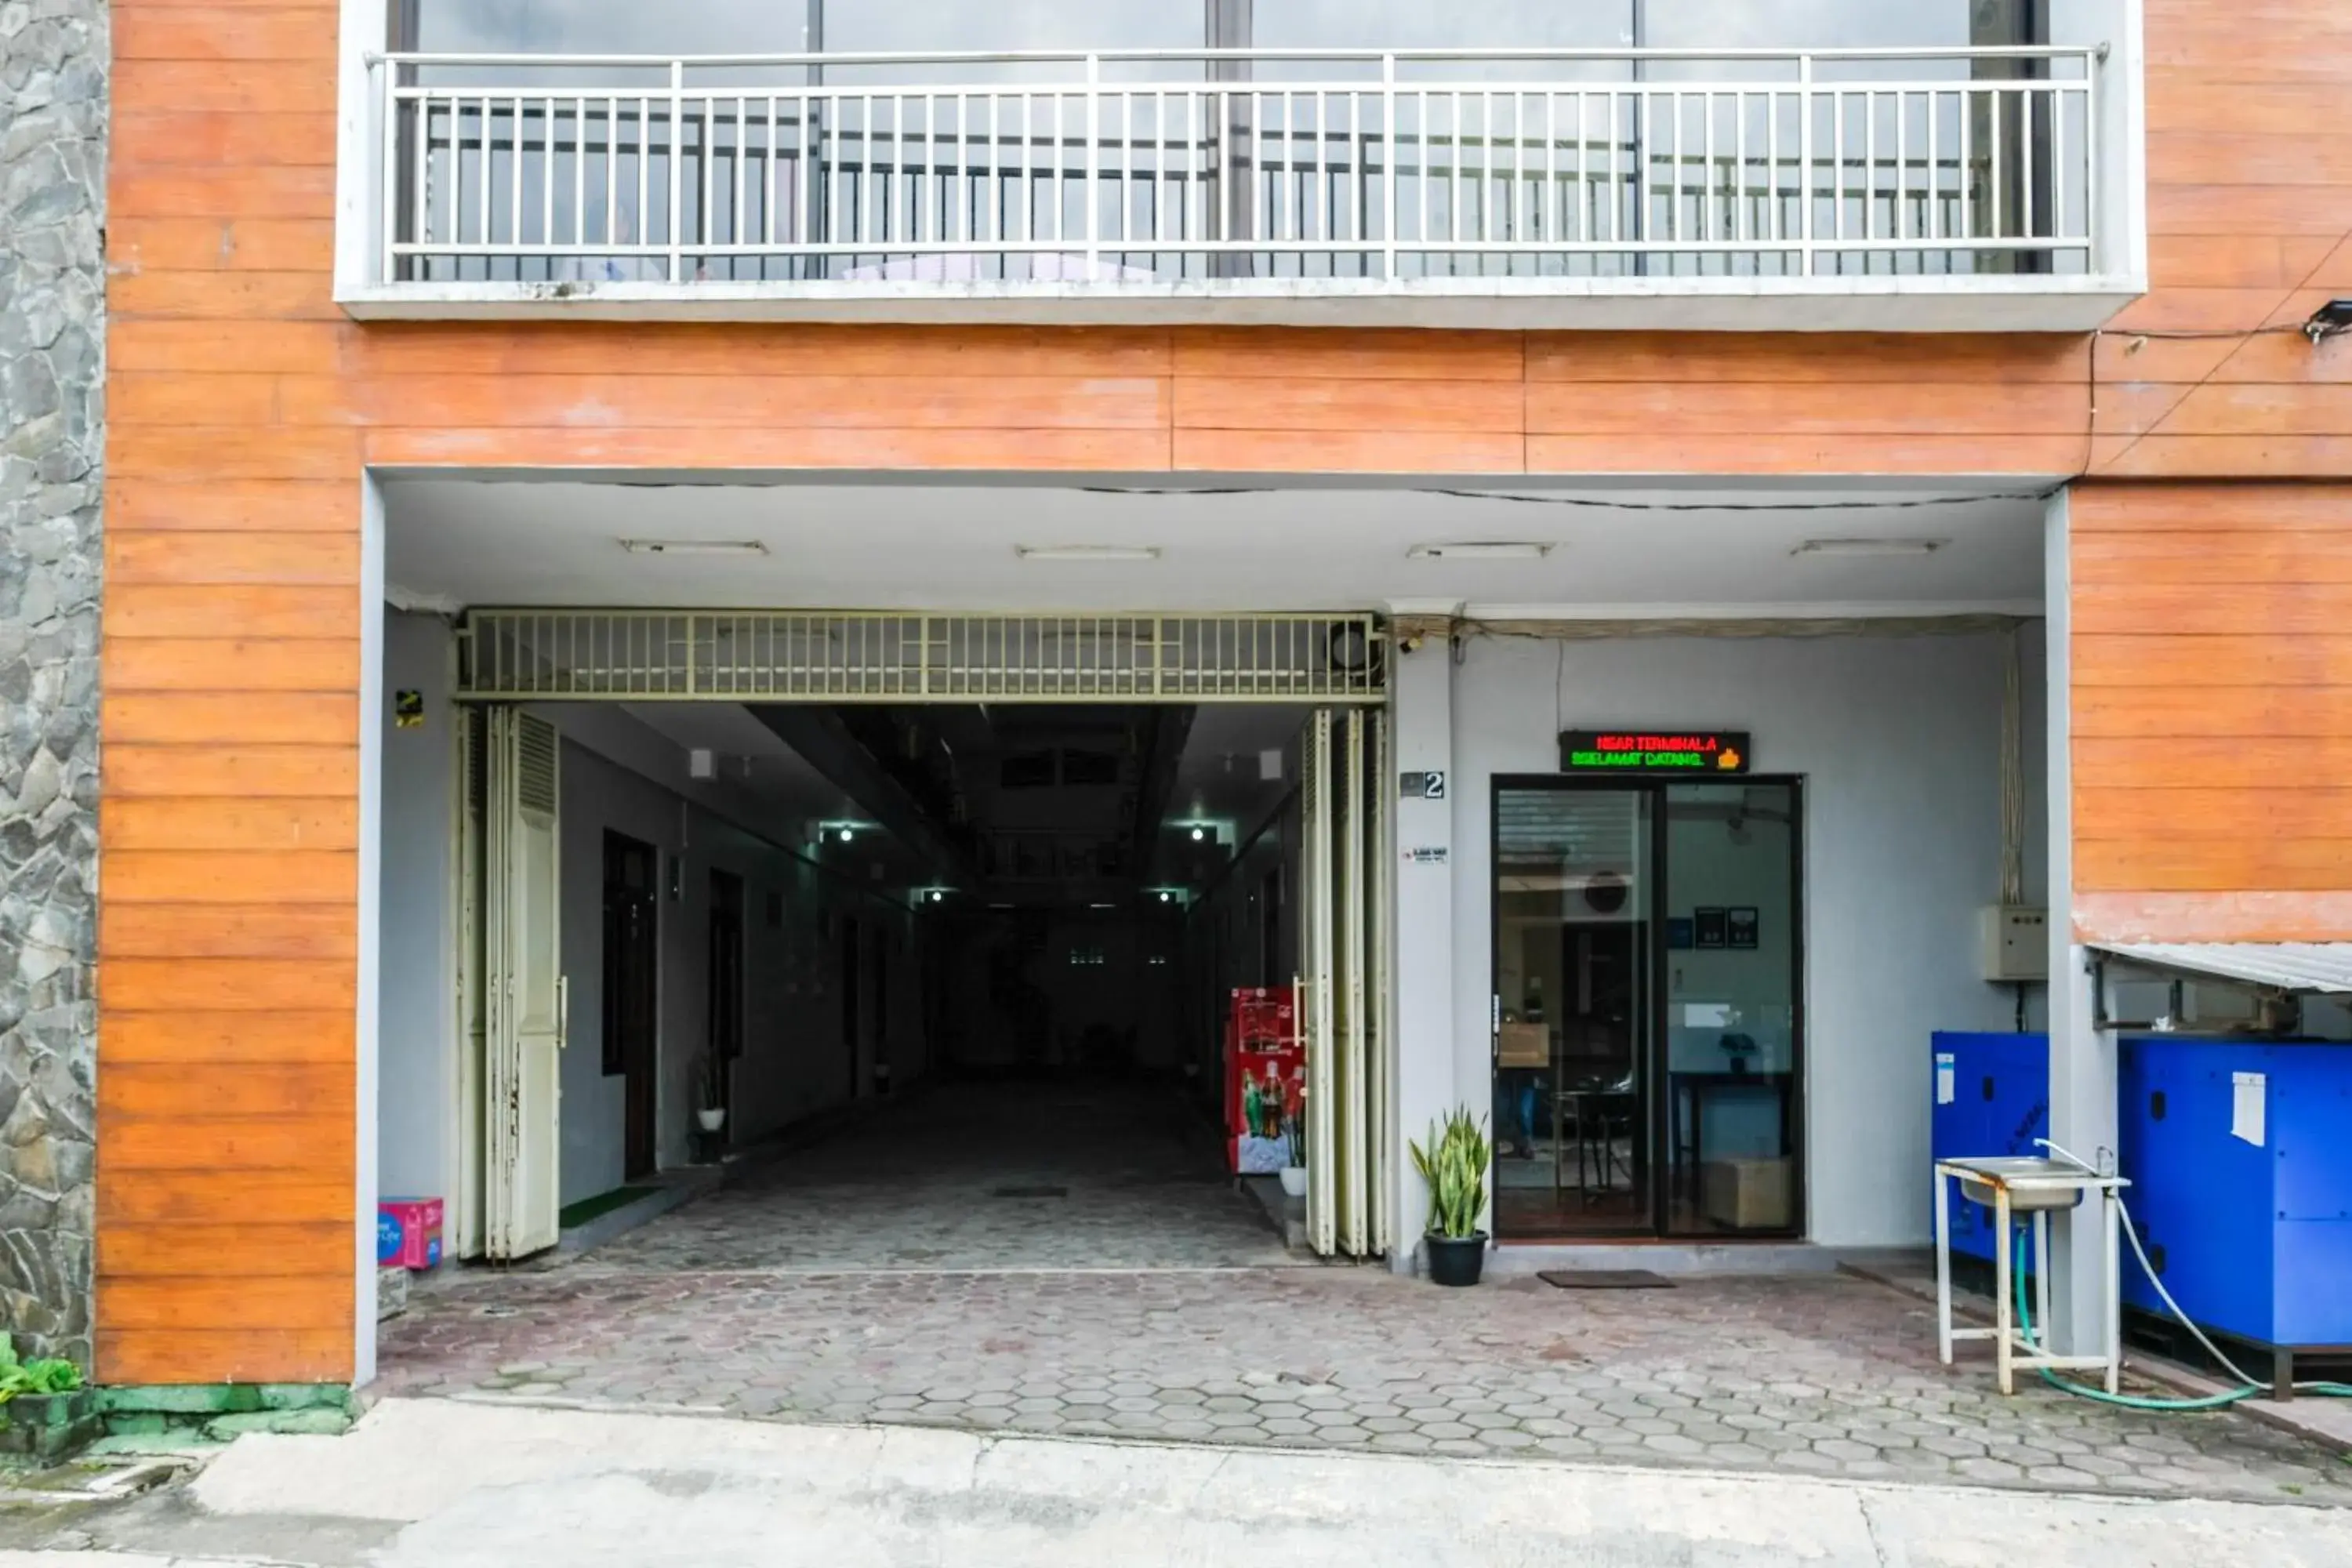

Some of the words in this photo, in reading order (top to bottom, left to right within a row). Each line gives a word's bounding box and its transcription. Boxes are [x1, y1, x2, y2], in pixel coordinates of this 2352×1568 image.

[1596, 735, 1634, 750] NEAR
[1636, 735, 1704, 750] TERMINAL
[1426, 772, 1443, 797] 2
